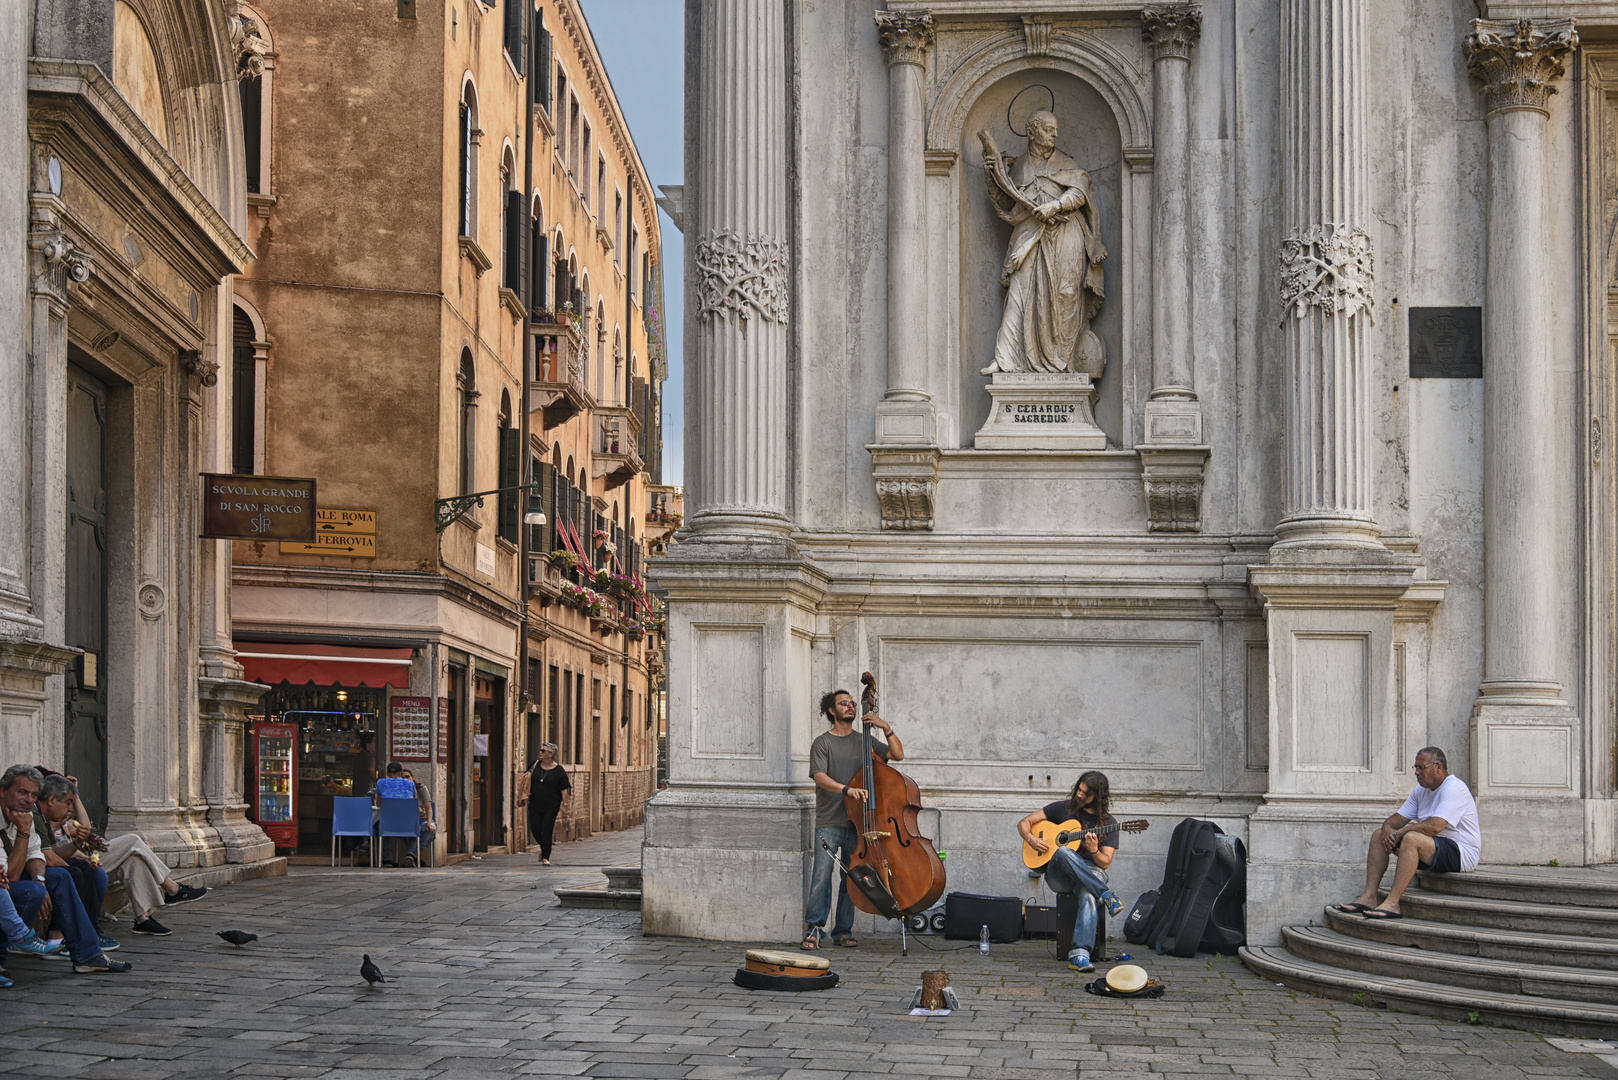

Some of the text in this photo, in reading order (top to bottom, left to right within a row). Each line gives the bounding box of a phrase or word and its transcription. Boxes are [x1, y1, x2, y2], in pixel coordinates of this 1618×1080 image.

[261, 487, 310, 499] GRANDE
[220, 501, 302, 514] DI SAN ROCCO
[342, 511, 373, 522] ROMA
[318, 535, 373, 547] FERROVIA
